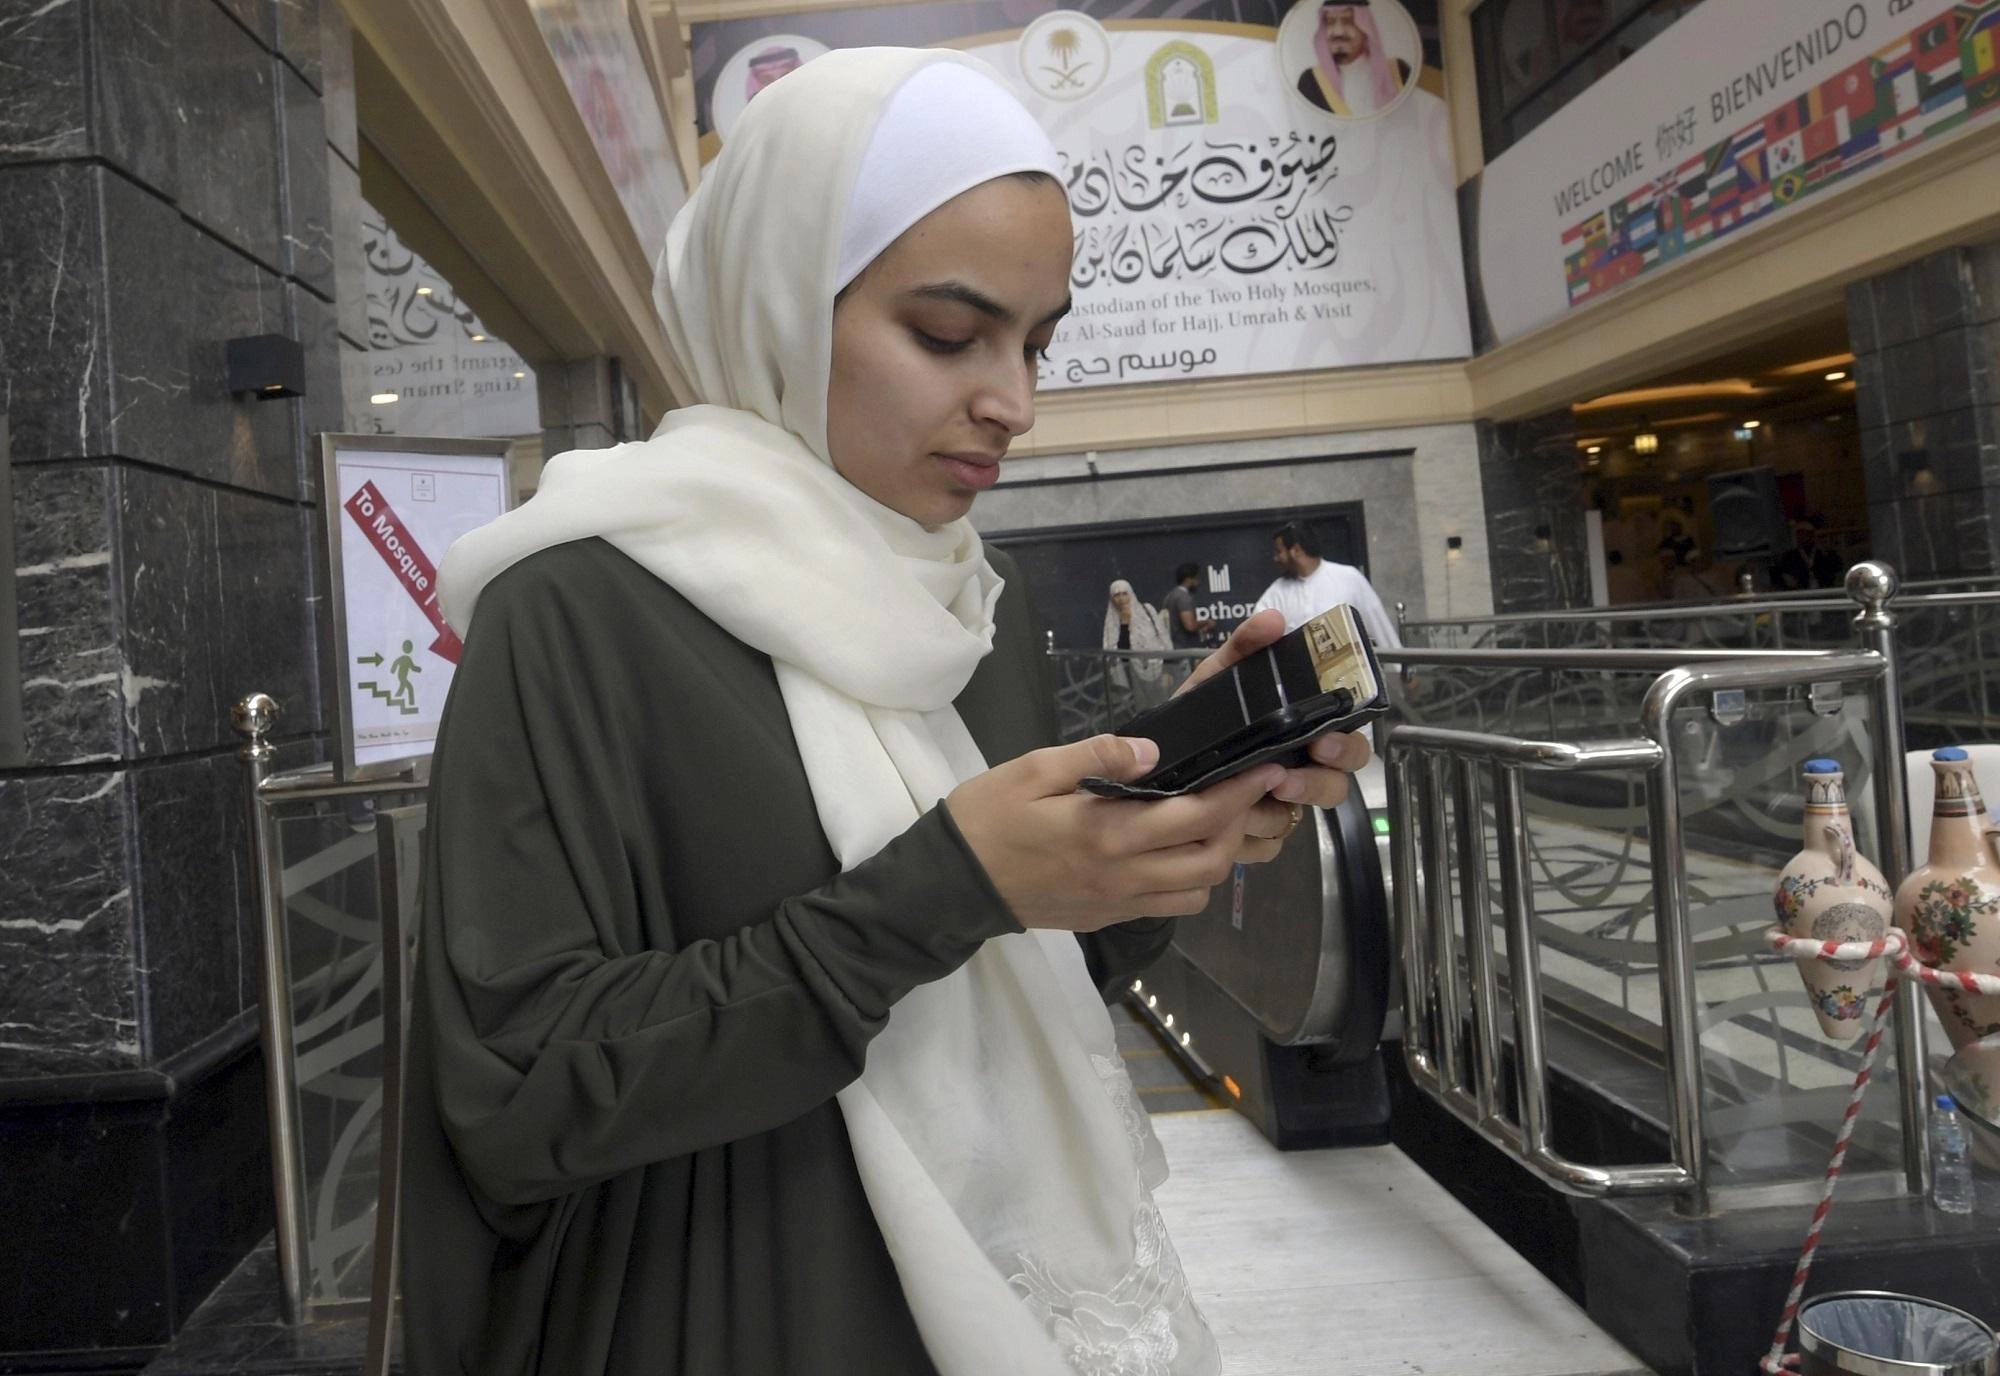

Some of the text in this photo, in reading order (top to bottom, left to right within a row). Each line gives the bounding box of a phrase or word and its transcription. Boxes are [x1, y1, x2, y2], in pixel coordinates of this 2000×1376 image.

[1554, 2, 1867, 217] WELCOME 你好 BIENVENIDO
[1071, 298, 1146, 317] ustodian
[1151, 295, 1168, 309] of
[1174, 291, 1202, 307] the
[1209, 288, 1242, 303] Two
[1248, 282, 1286, 302] Holy
[1076, 318, 1146, 341] Al-Saud
[1152, 318, 1176, 334] for
[1228, 306, 1289, 327] Umrah
[1294, 304, 1307, 321] &
[1313, 302, 1352, 319] Visit
[1066, 356, 1111, 383] حج
[1118, 343, 1217, 379] موسم
[356, 488, 375, 517] To
[371, 514, 429, 592] Mosque
[1195, 600, 1256, 621] pthor
